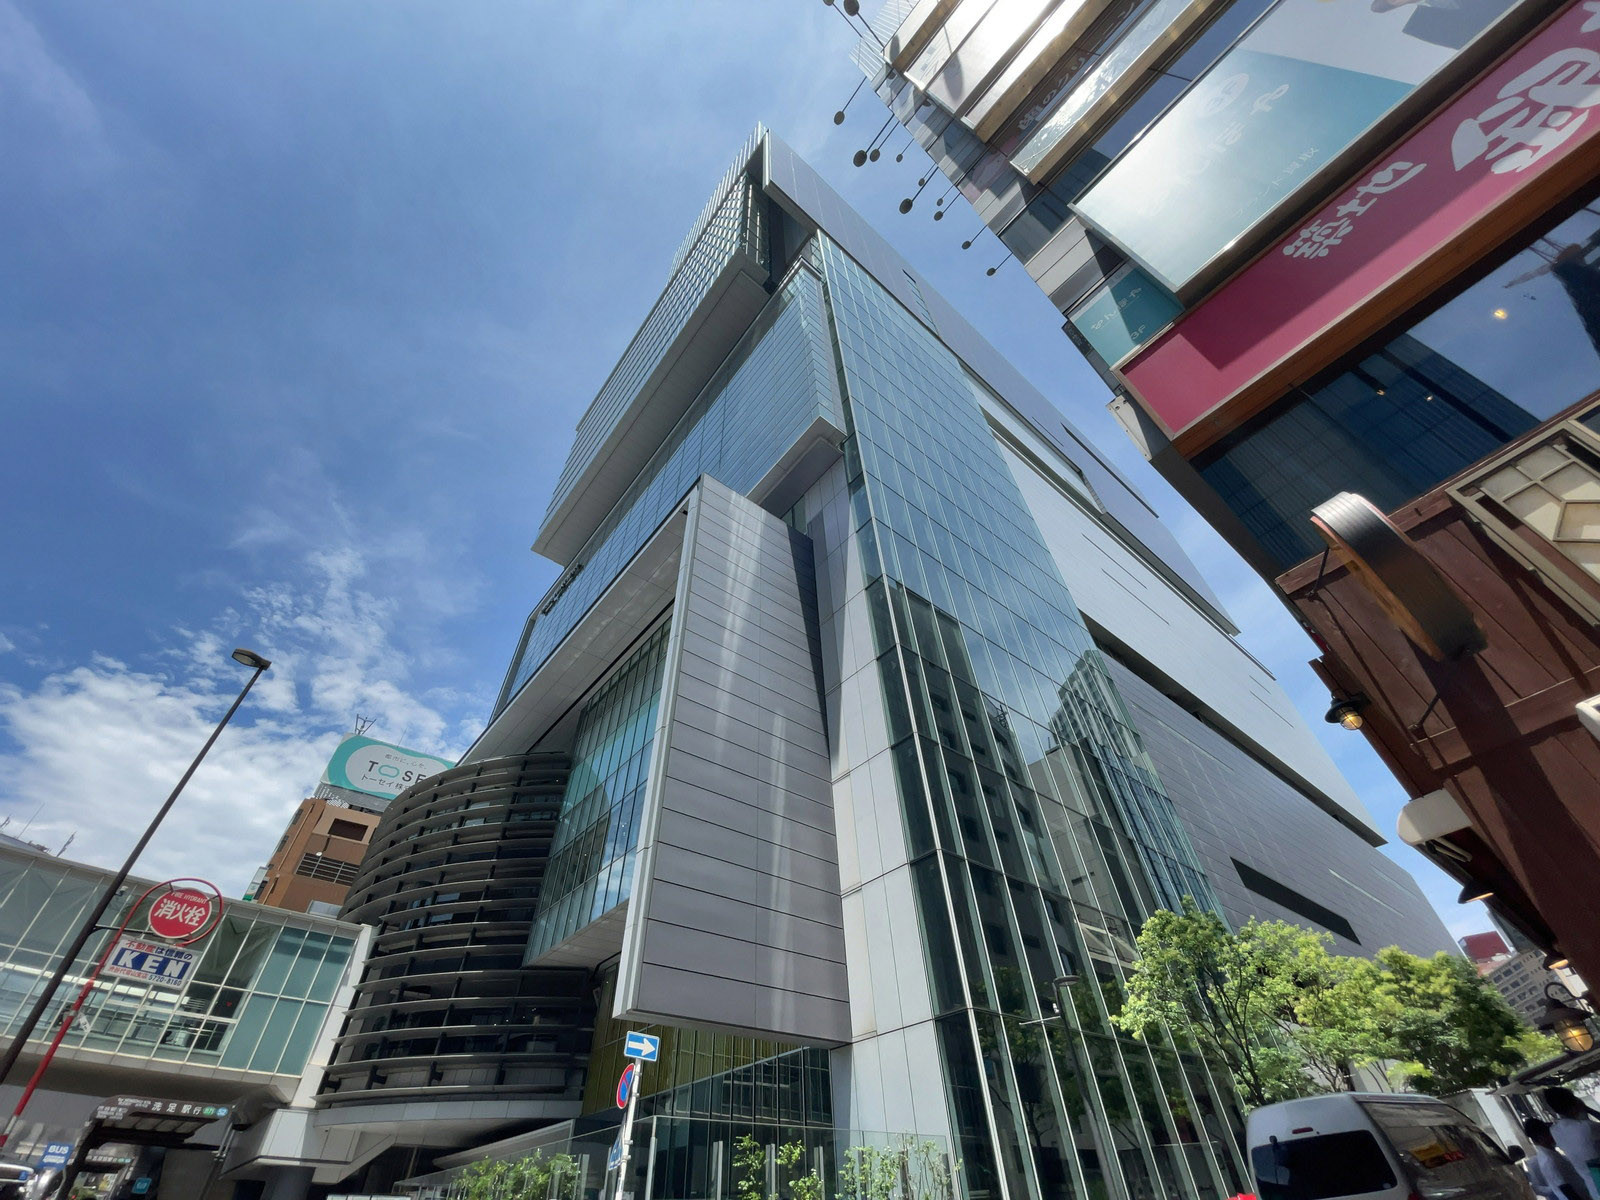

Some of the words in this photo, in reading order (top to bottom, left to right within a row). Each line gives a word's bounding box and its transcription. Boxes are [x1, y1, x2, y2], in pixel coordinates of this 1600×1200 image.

[1282, 161, 1427, 260] 築地
[154, 898, 206, 926] 消火栓
[170, 891, 184, 899] FIRE
[184, 893, 208, 905] HYDRANT
[117, 949, 185, 978] KEN
[48, 1144, 69, 1154] BUS
